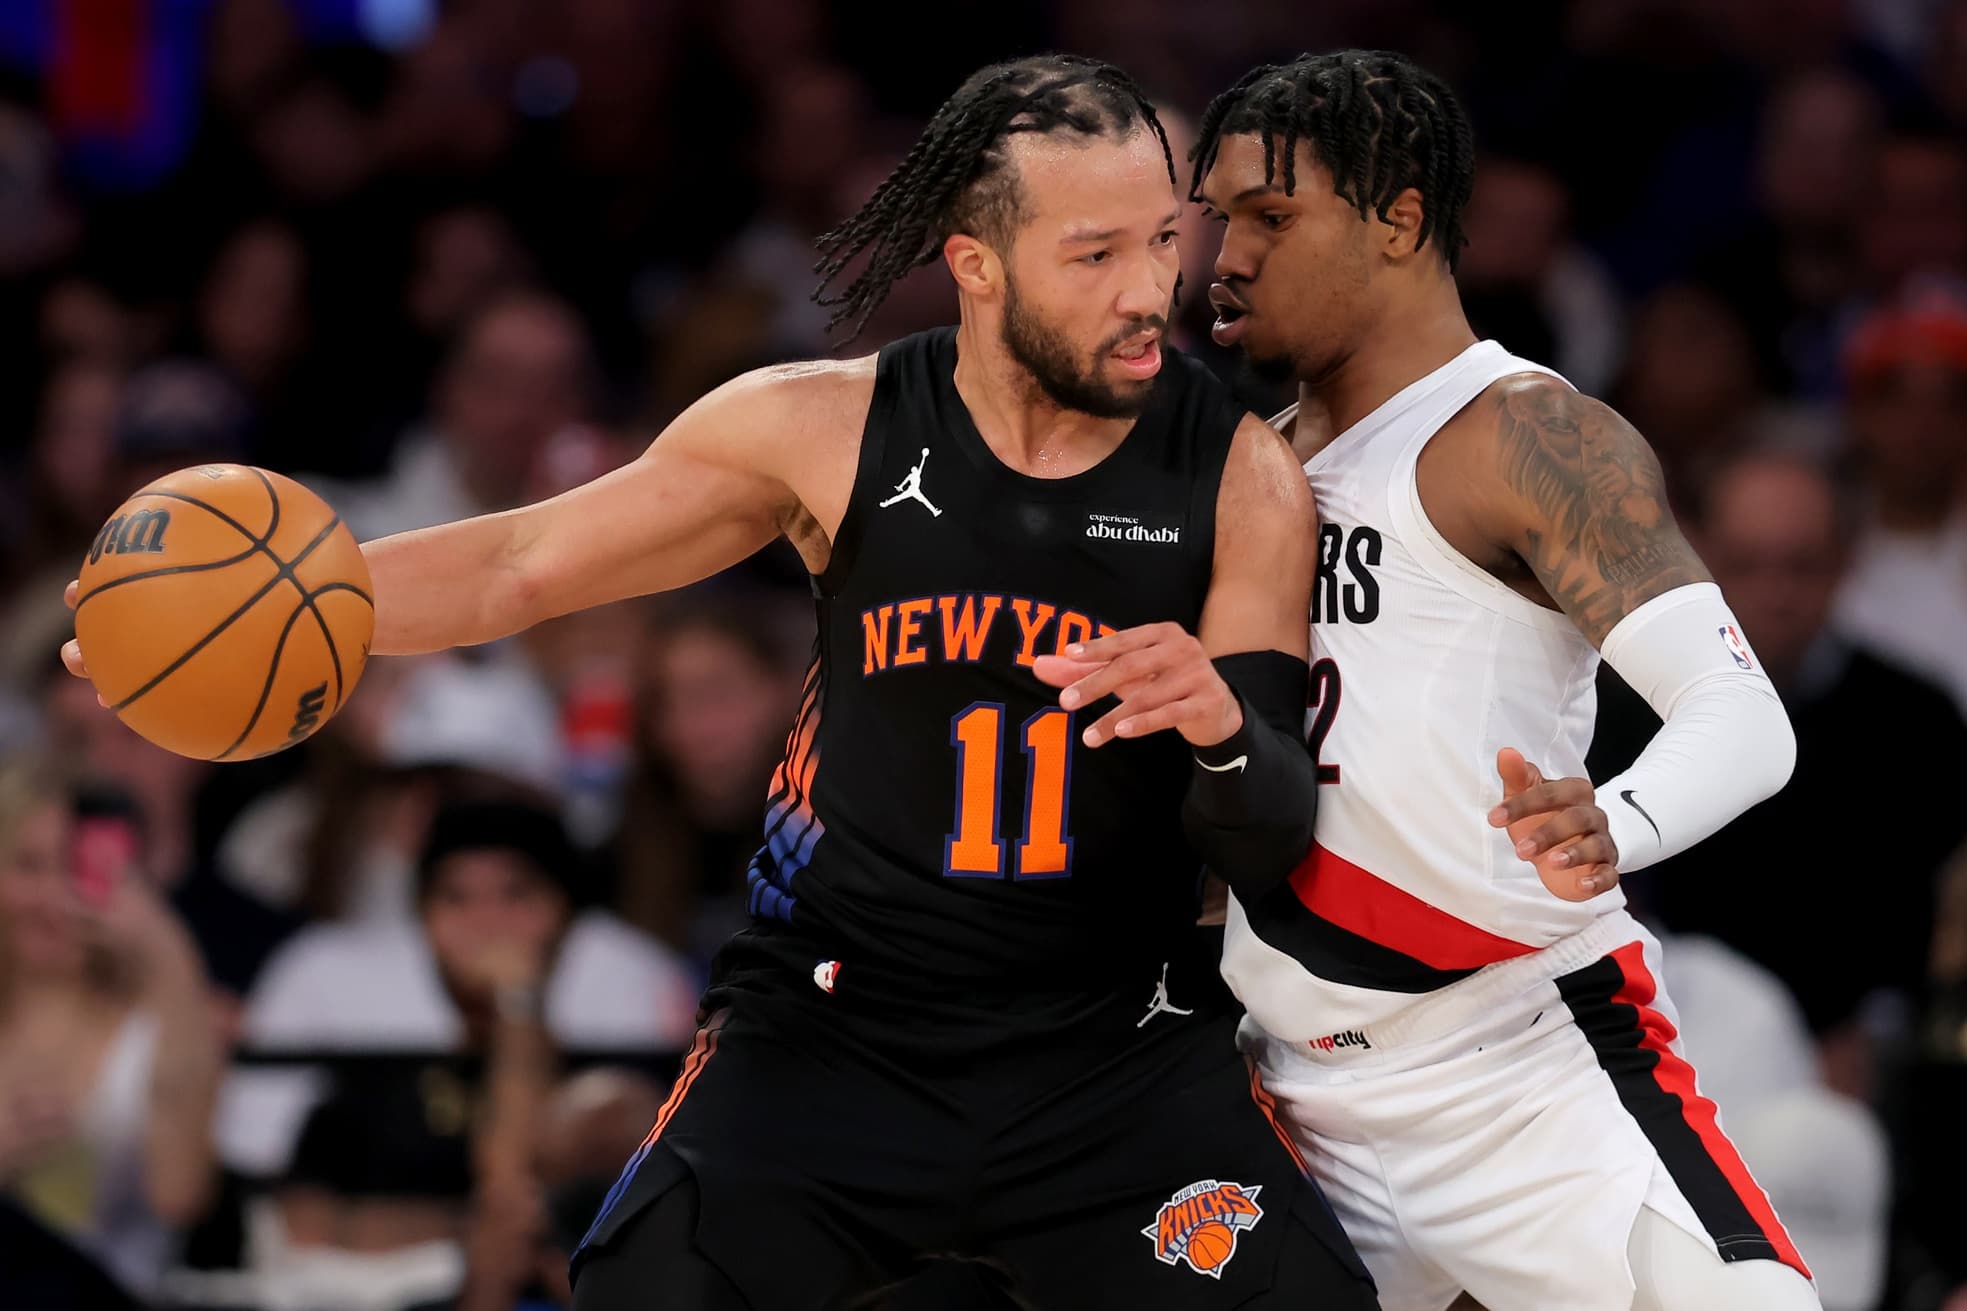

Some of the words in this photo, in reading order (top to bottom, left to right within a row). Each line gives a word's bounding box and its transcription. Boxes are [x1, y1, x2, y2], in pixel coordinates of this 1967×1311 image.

[1086, 523, 1122, 540] abu
[1125, 525, 1180, 543] dhabi
[1089, 513, 1139, 524] experience
[861, 594, 1003, 678] NEW
[1010, 597, 1120, 669] YO
[943, 700, 1076, 880] 11
[1174, 1187, 1192, 1205] NEW
[1193, 1182, 1217, 1194] YORK
[1158, 1184, 1260, 1257] KNICKS
